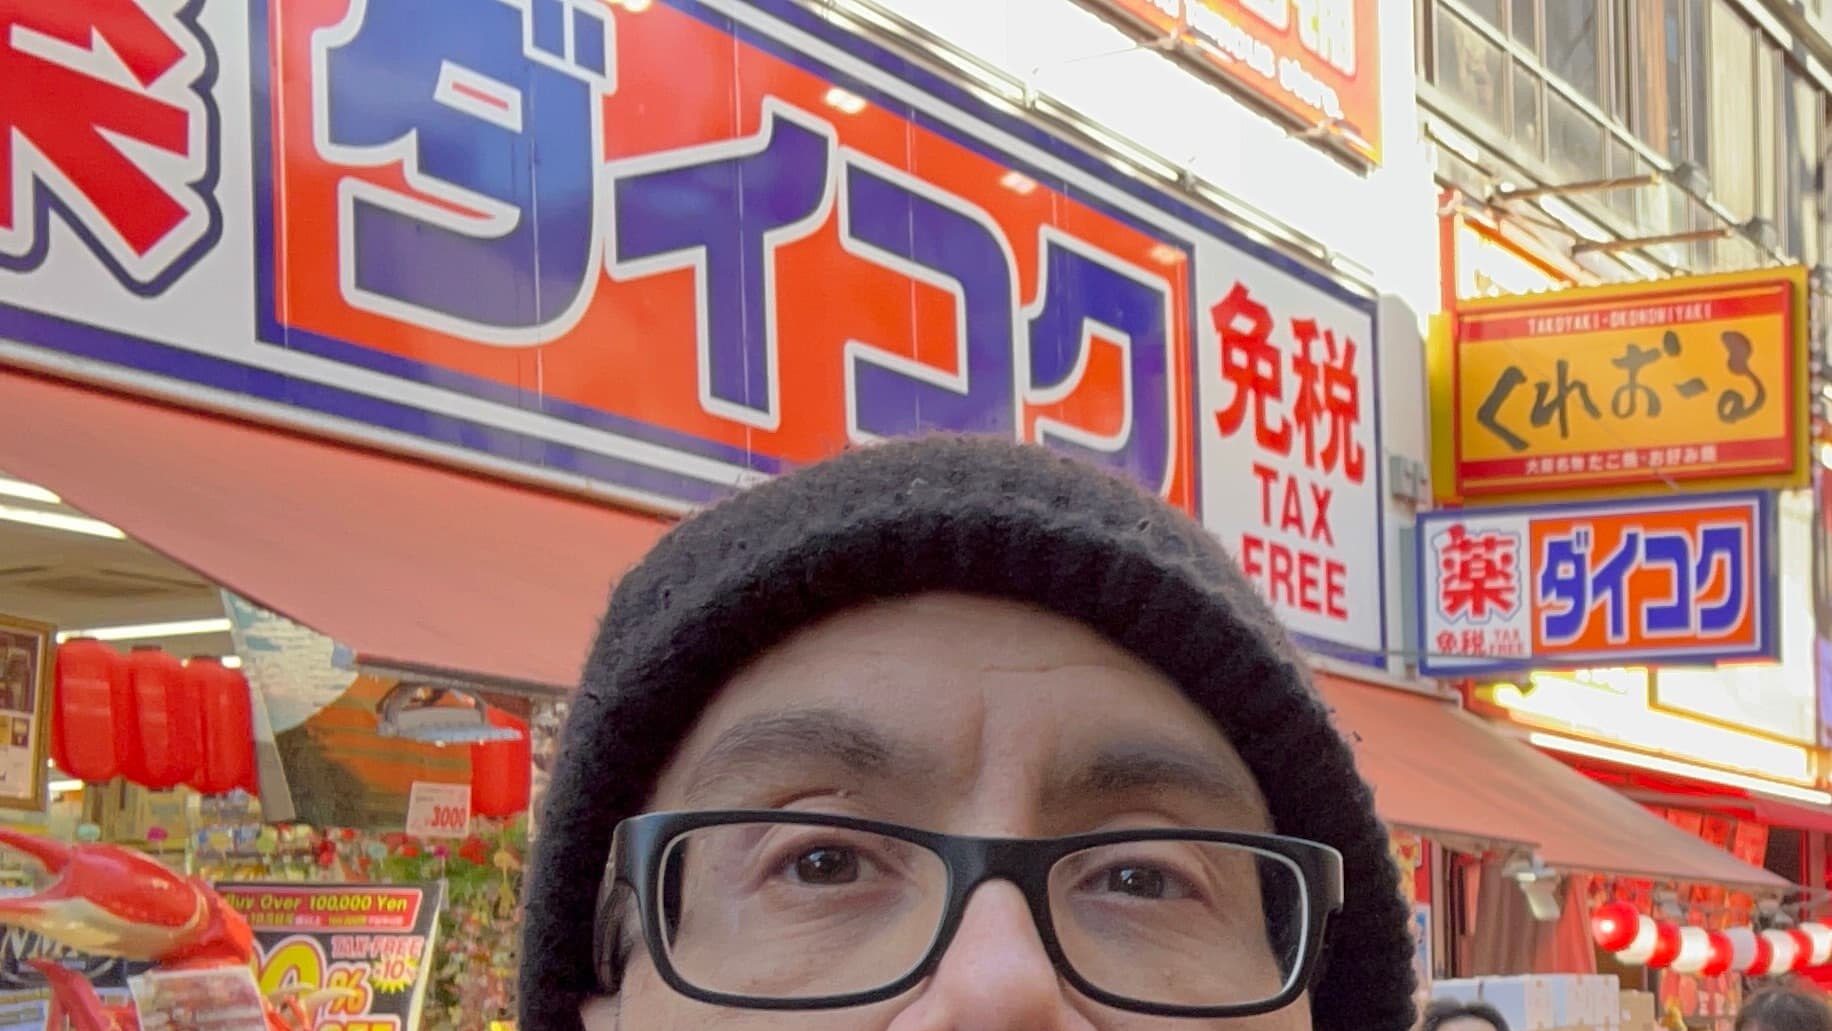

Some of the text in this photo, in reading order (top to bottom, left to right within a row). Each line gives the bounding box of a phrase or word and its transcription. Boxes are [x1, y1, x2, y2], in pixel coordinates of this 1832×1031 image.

[322, 0, 1175, 498] ダイコク
[1210, 280, 1365, 486] 免税
[1475, 329, 1767, 452] くれおーる
[1252, 462, 1335, 548] TAX
[1241, 535, 1348, 622] FREE
[1440, 523, 1517, 618] 薬
[1539, 524, 1746, 643] ダイコク
[1436, 628, 1485, 657] 免税
[259, 895, 300, 911] Over
[310, 895, 373, 912] 100,000
[377, 895, 408, 912] Yen
